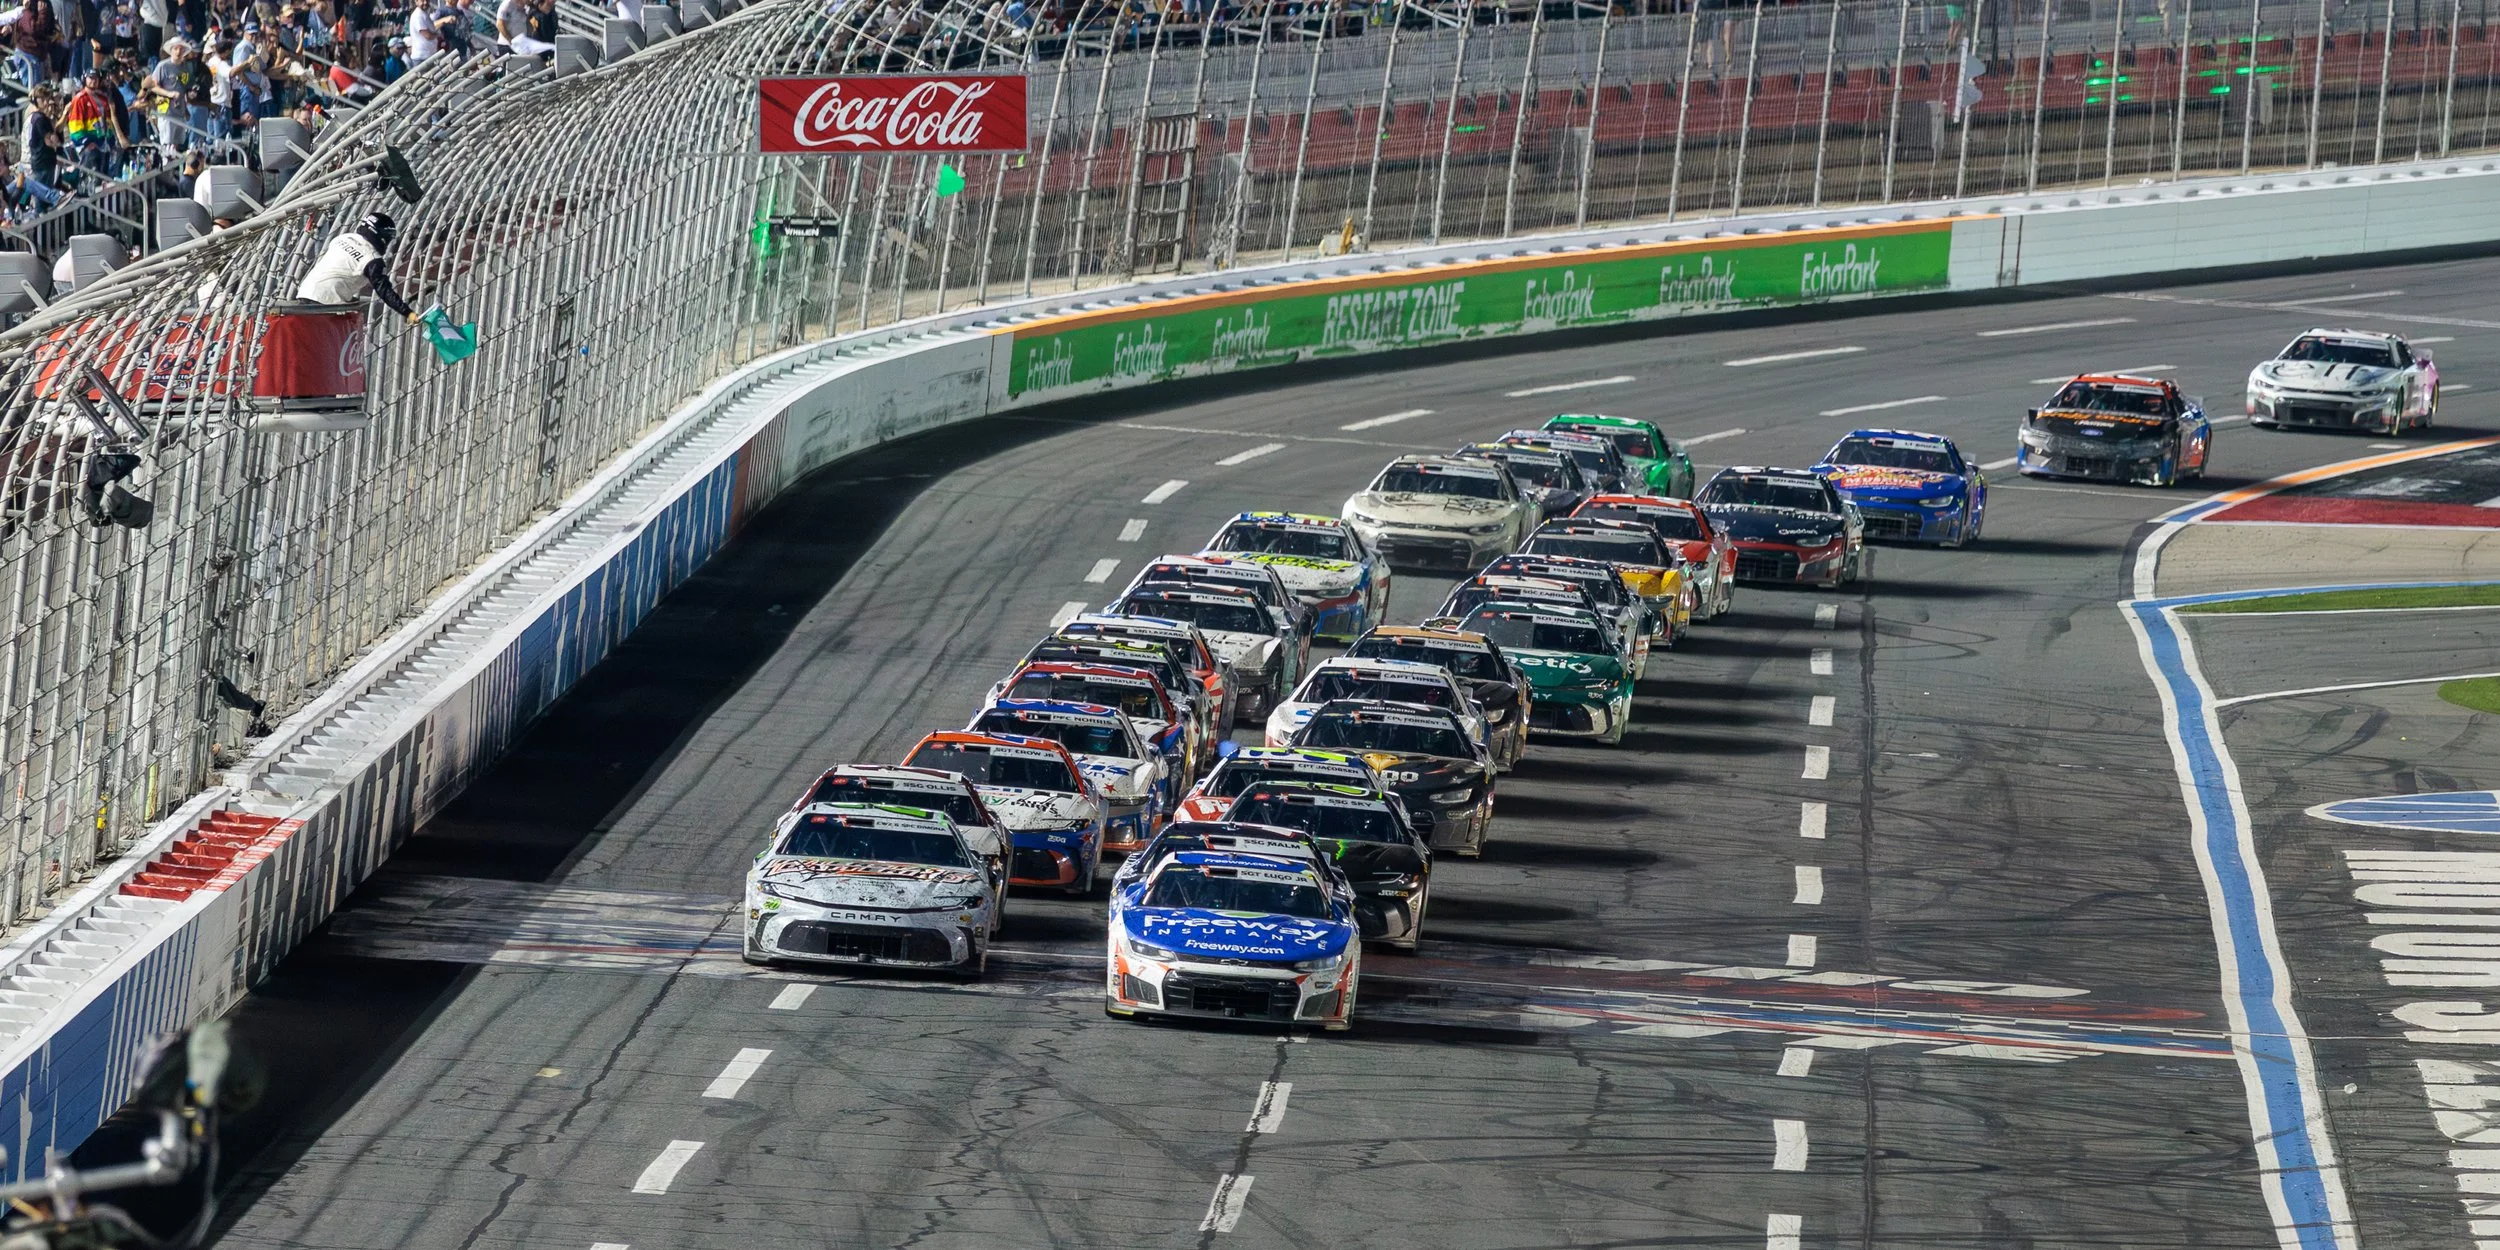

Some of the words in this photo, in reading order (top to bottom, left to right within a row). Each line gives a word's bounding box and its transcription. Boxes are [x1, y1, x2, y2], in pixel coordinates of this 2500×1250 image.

[794, 81, 995, 147] Coca-Cola
[1801, 244, 1880, 297] EchoPark
[1661, 255, 1736, 304] EchoPark
[1524, 270, 1593, 320] EchoPark
[1323, 290, 1408, 348] RESTART
[1408, 281, 1465, 341] ZONE
[1212, 308, 1270, 359] EchoPark
[1113, 323, 1167, 378] EchoPark
[1027, 337, 1074, 392] EchoPark
[1073, 716, 1114, 725] NORRIS
[1015, 748, 1042, 757] CROW
[1315, 765, 1359, 775] JACOBSEN
[903, 781, 924, 789] SSG
[923, 783, 957, 792] OLLIS
[1327, 798, 1349, 806] SSG
[1350, 800, 1373, 808] SKY
[1243, 838, 1266, 846] SSG
[1266, 840, 1301, 850] MALM
[1203, 857, 1278, 869] Freeway.com
[1240, 870, 1262, 878] SGT
[830, 911, 901, 922] CAMRY
[1144, 914, 1329, 941] Freeway
[1143, 927, 1326, 950] INSURANCE
[1185, 939, 1285, 955] Freeway.com
[1137, 965, 1146, 977] 7
